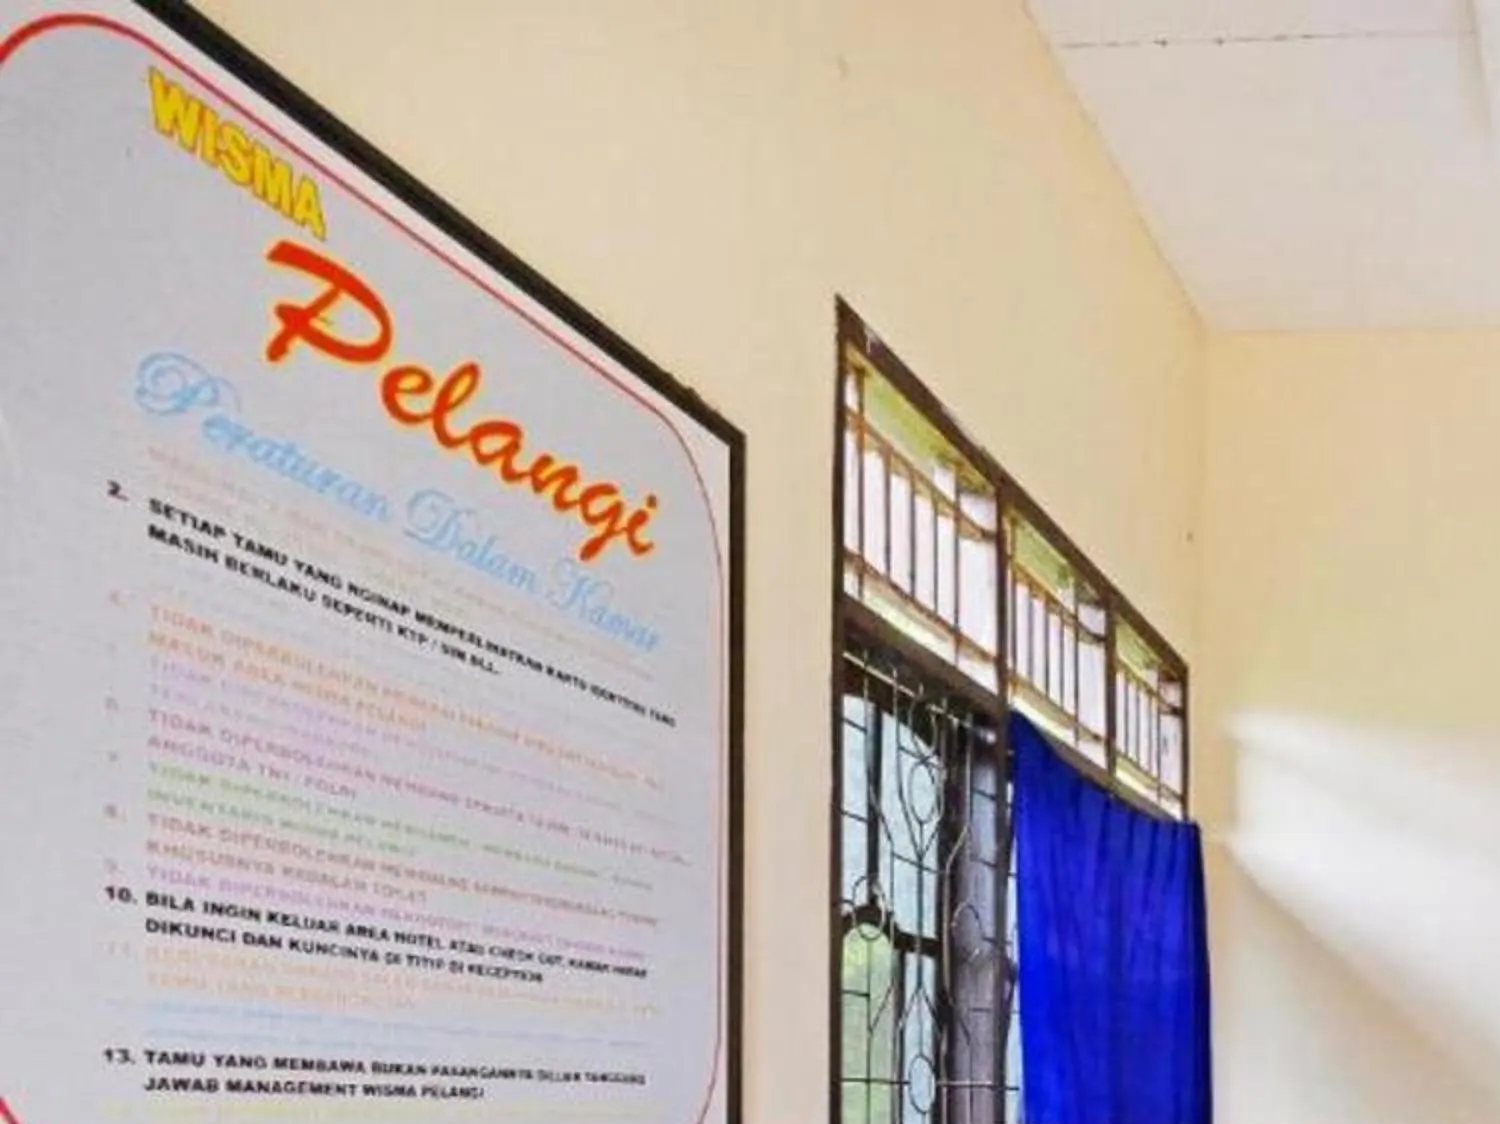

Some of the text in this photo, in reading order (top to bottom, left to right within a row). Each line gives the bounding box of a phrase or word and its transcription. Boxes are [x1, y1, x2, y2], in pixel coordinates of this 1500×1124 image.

[148, 66, 326, 240] WISMA
[265, 240, 660, 562] Pelangi
[135, 352, 392, 522] Peraturan
[402, 489, 538, 593] Dalam
[546, 556, 659, 652] Kamar
[107, 479, 130, 501] 2.
[148, 497, 227, 539] SETIAP
[231, 531, 288, 566] TAMU
[293, 559, 343, 591] YANG
[347, 581, 411, 616] NGINAP
[147, 523, 218, 563] MASIH
[224, 554, 316, 602] BERLAKU
[321, 594, 392, 633] SEPERTI
[397, 624, 428, 646] KTP
[441, 643, 467, 662] SIM
[148, 706, 213, 738] TIDAK
[147, 735, 251, 772] ANGGOTA
[147, 812, 212, 838] TIDAK
[103, 885, 138, 905] 10.
[145, 890, 195, 913] BILA
[202, 901, 261, 923] INGIN
[266, 911, 340, 934] KELUAR
[344, 923, 390, 943] AREA
[393, 930, 442, 952] HOTEL
[145, 917, 236, 943] DIKUNCI
[242, 931, 283, 951] DAN
[288, 938, 380, 963] KUNCINYA
[405, 953, 445, 971] TITIP
[103, 1047, 136, 1066] 13.
[144, 1049, 207, 1068] TAMU
[213, 1053, 268, 1071] YANG
[272, 1056, 367, 1074] MEMBAWA
[371, 1060, 427, 1077] BUKAN
[143, 1076, 485, 1101] JAWAB MANAGEMENT WISMA PELANGI
